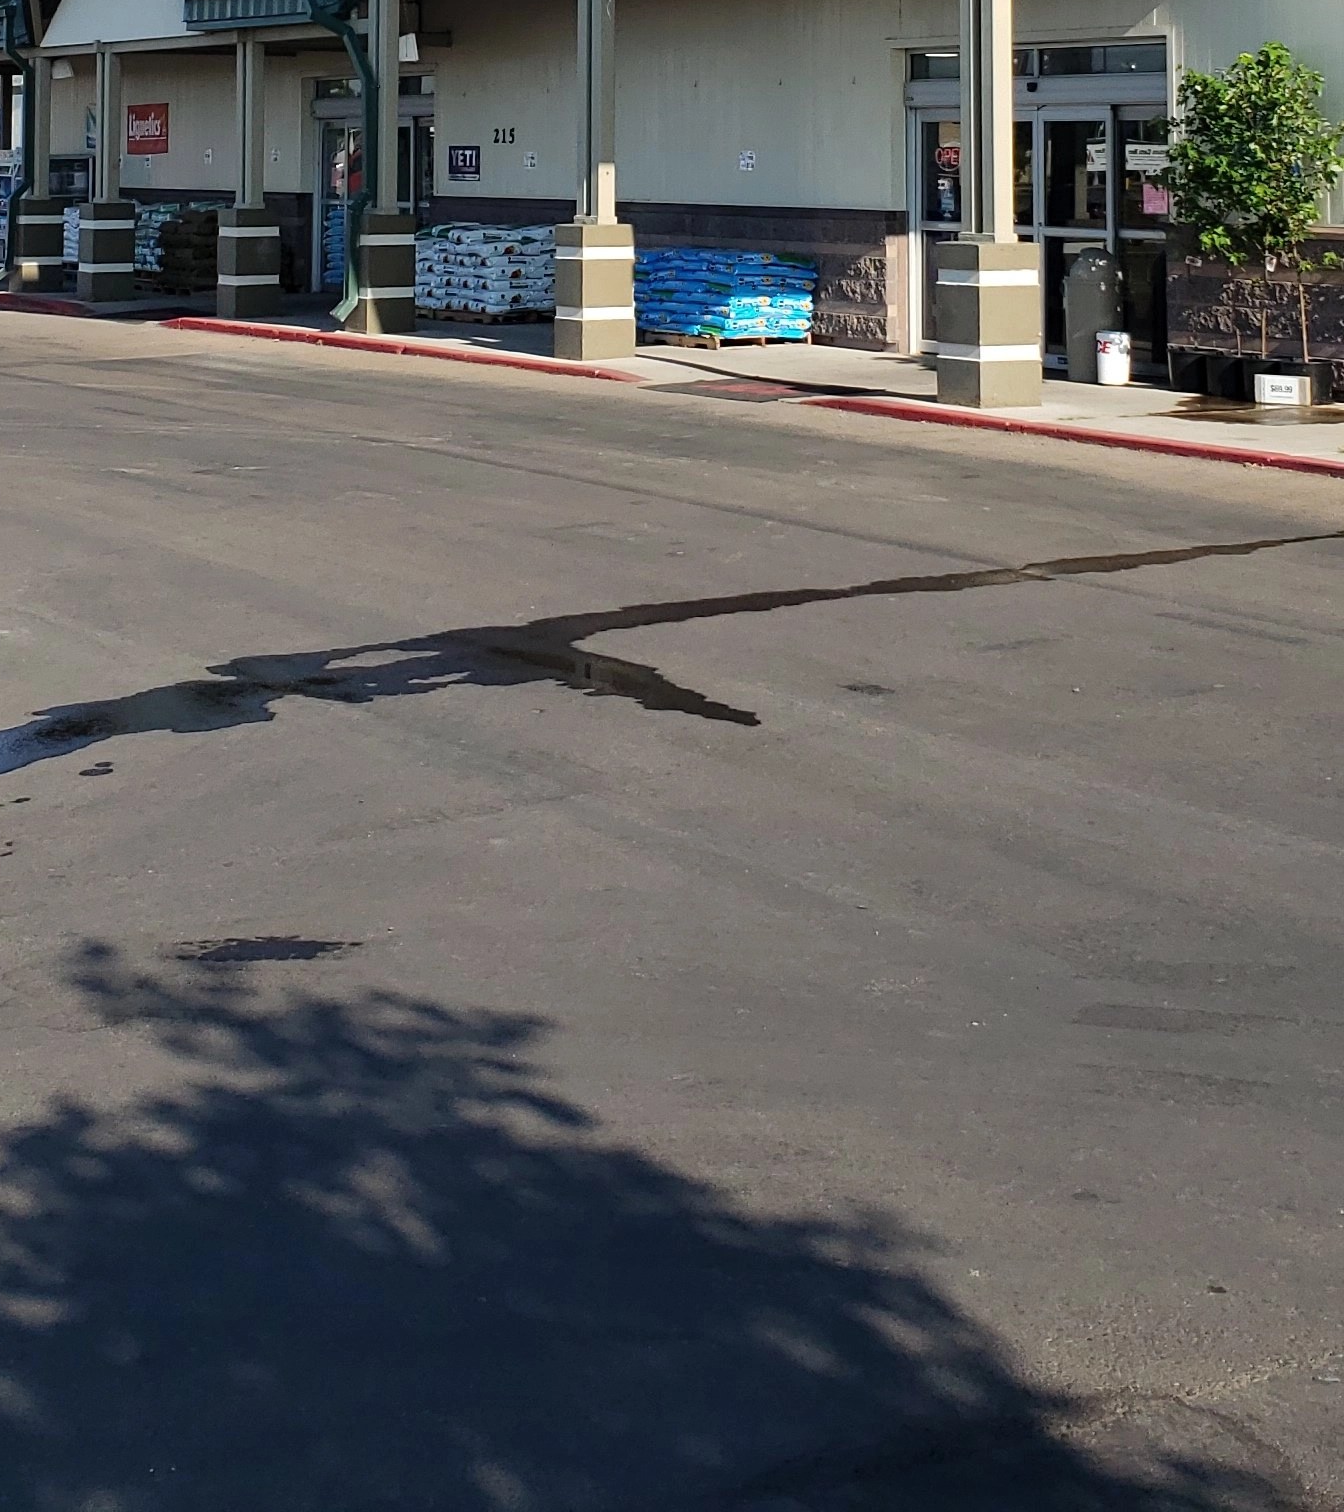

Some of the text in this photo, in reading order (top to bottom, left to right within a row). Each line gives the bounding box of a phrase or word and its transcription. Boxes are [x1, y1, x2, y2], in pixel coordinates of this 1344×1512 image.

[493, 127, 516, 145] 215
[451, 149, 477, 167] YETI
[935, 147, 961, 165] OPE
